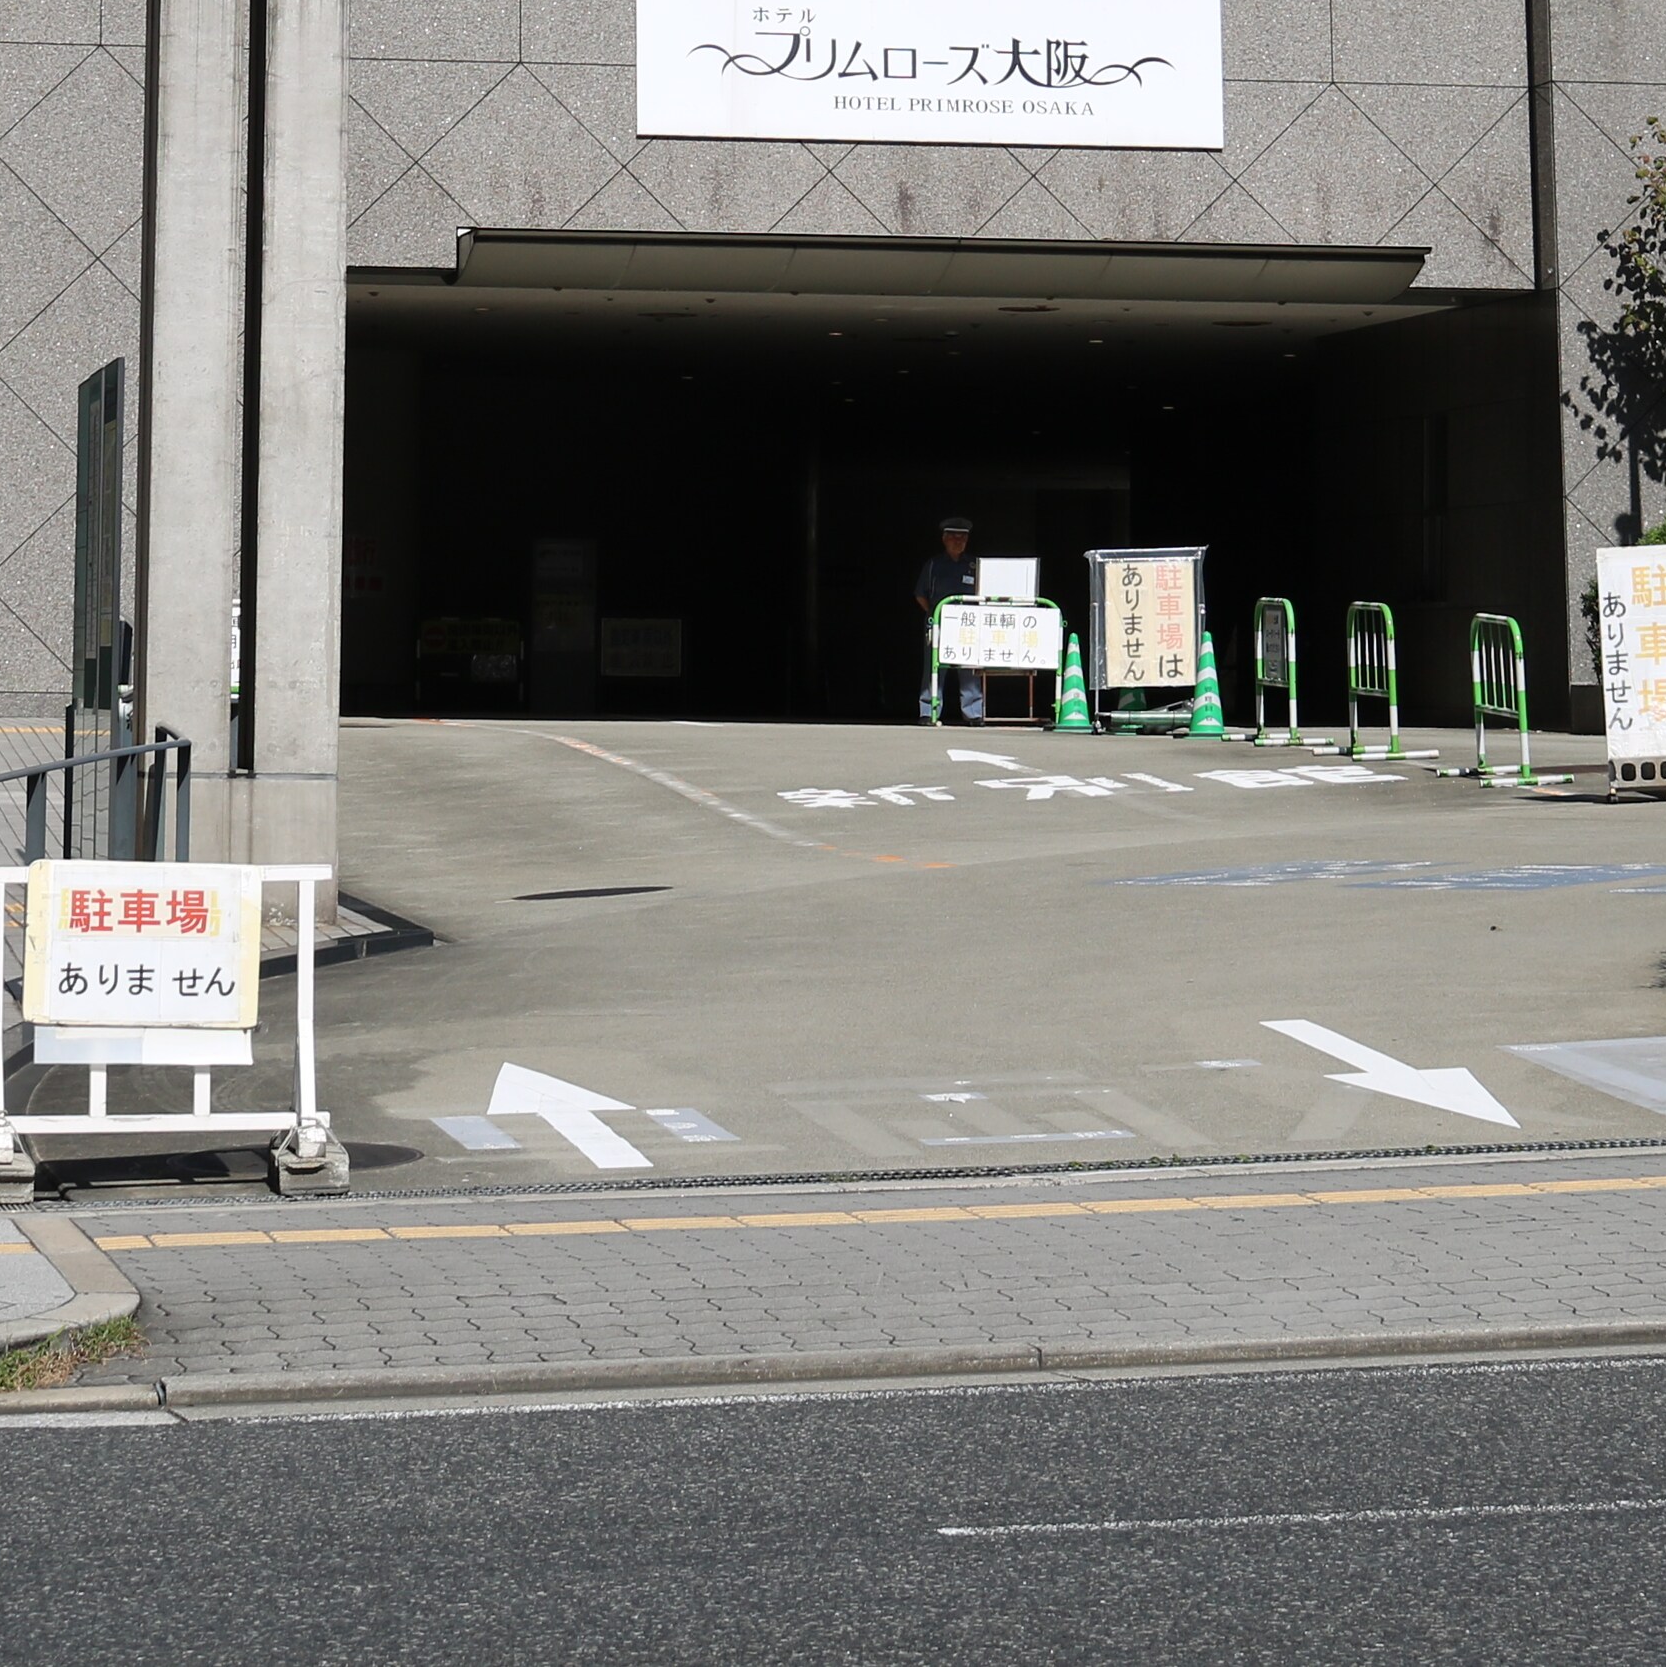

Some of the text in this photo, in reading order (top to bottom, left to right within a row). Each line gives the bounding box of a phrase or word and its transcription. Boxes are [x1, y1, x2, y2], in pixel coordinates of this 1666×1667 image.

[752, 6, 816, 24] ホテル
[738, 25, 1098, 89] プリムローズ大阪
[833, 95, 1095, 117] HOTEL PRIMROSE OSAKA
[1121, 563, 1145, 682] ありません
[1155, 564, 1184, 679] 駐車場は
[942, 644, 1046, 665] ありません。
[1602, 590, 1634, 731] ありません
[68, 888, 210, 934] 駐車場
[57, 961, 236, 998] ありません
